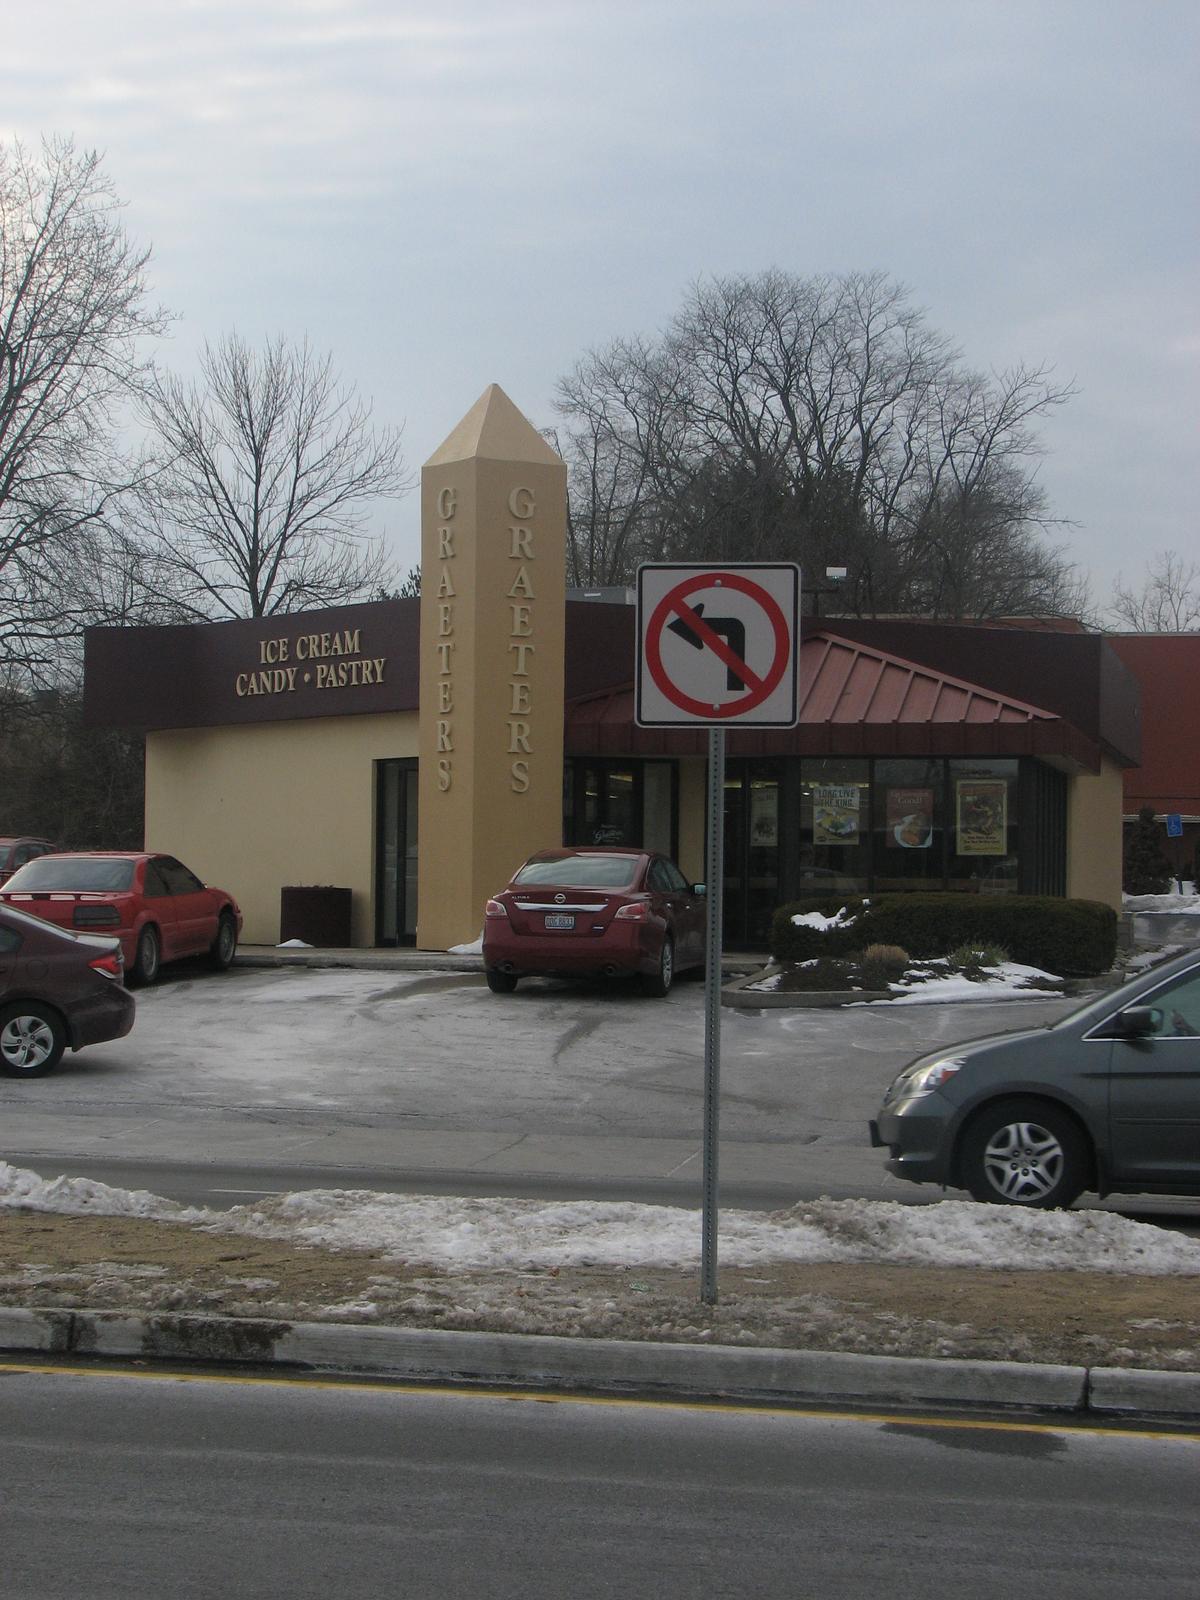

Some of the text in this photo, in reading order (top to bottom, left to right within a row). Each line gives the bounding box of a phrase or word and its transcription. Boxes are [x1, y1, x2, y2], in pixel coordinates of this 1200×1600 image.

[235, 658, 385, 697] CANDY PASTRY
[259, 629, 361, 665] ICE CREAM
[437, 487, 456, 792] GRAETERS
[507, 487, 537, 794] GRAETERS
